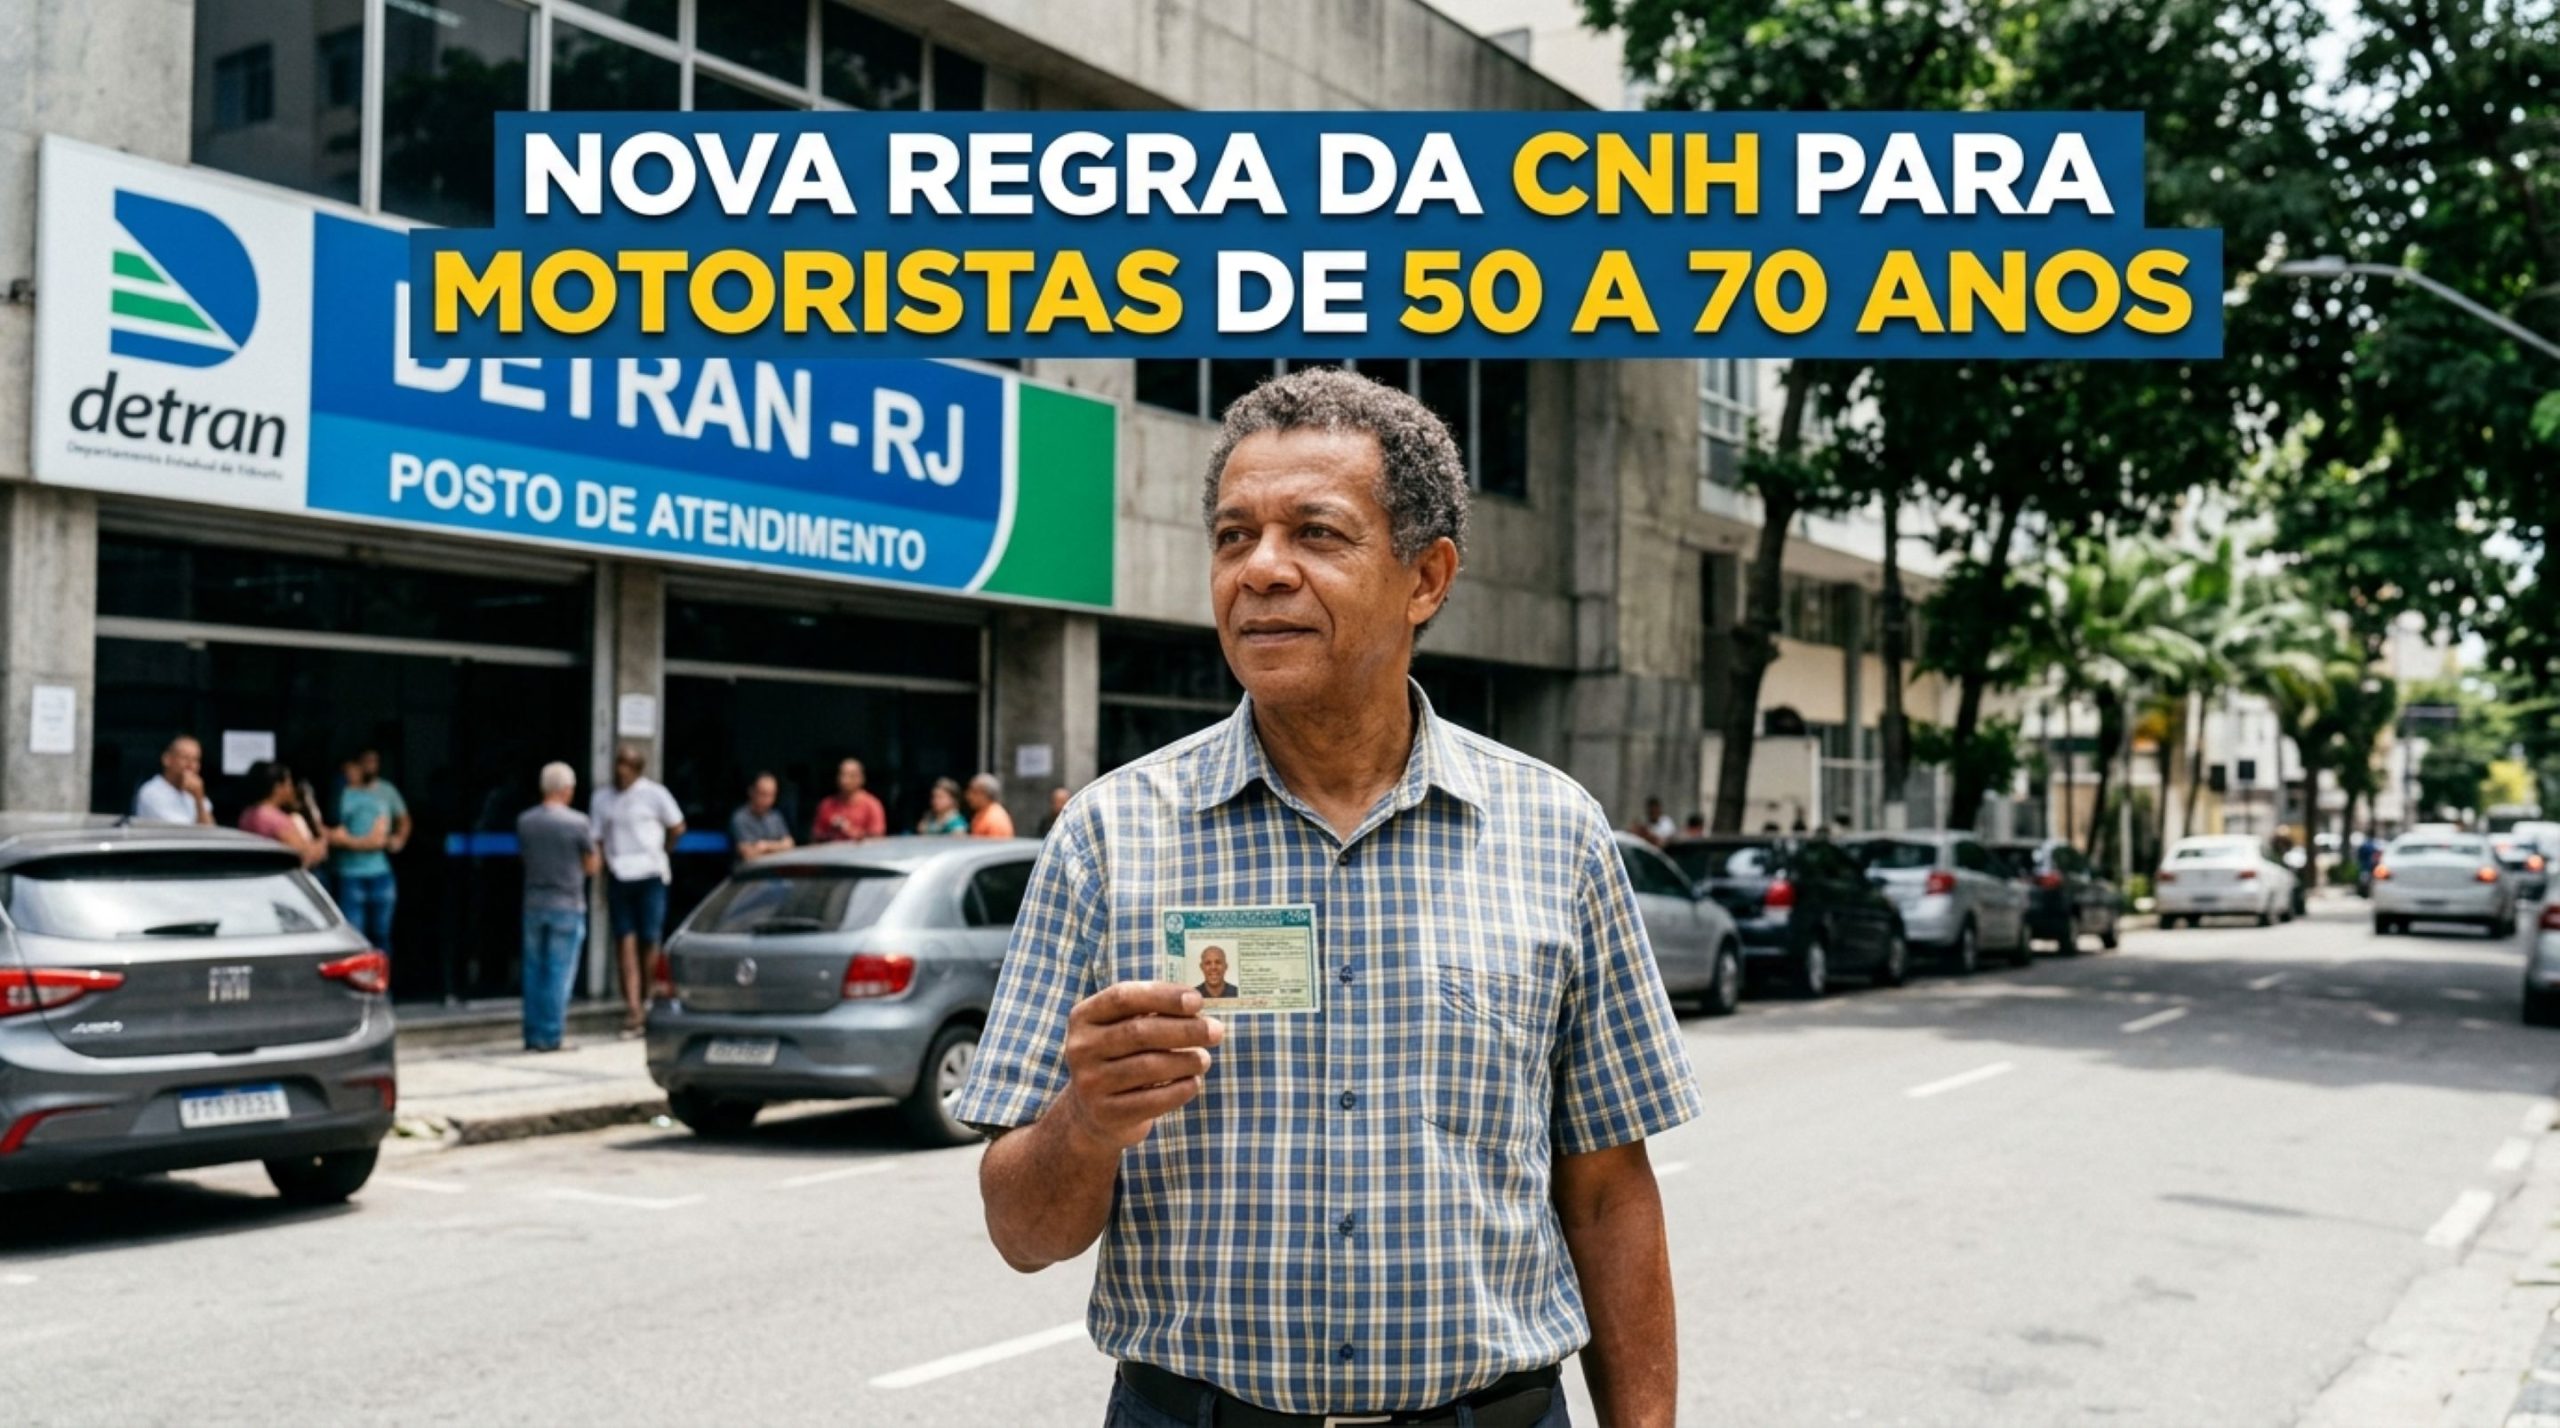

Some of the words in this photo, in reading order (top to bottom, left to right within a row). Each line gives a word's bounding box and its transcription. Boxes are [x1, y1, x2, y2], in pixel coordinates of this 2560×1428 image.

[69, 370, 287, 459] detran
[390, 452, 563, 523] POSTO
[575, 480, 638, 533] DE
[646, 492, 927, 572] ATENDIMENTO
